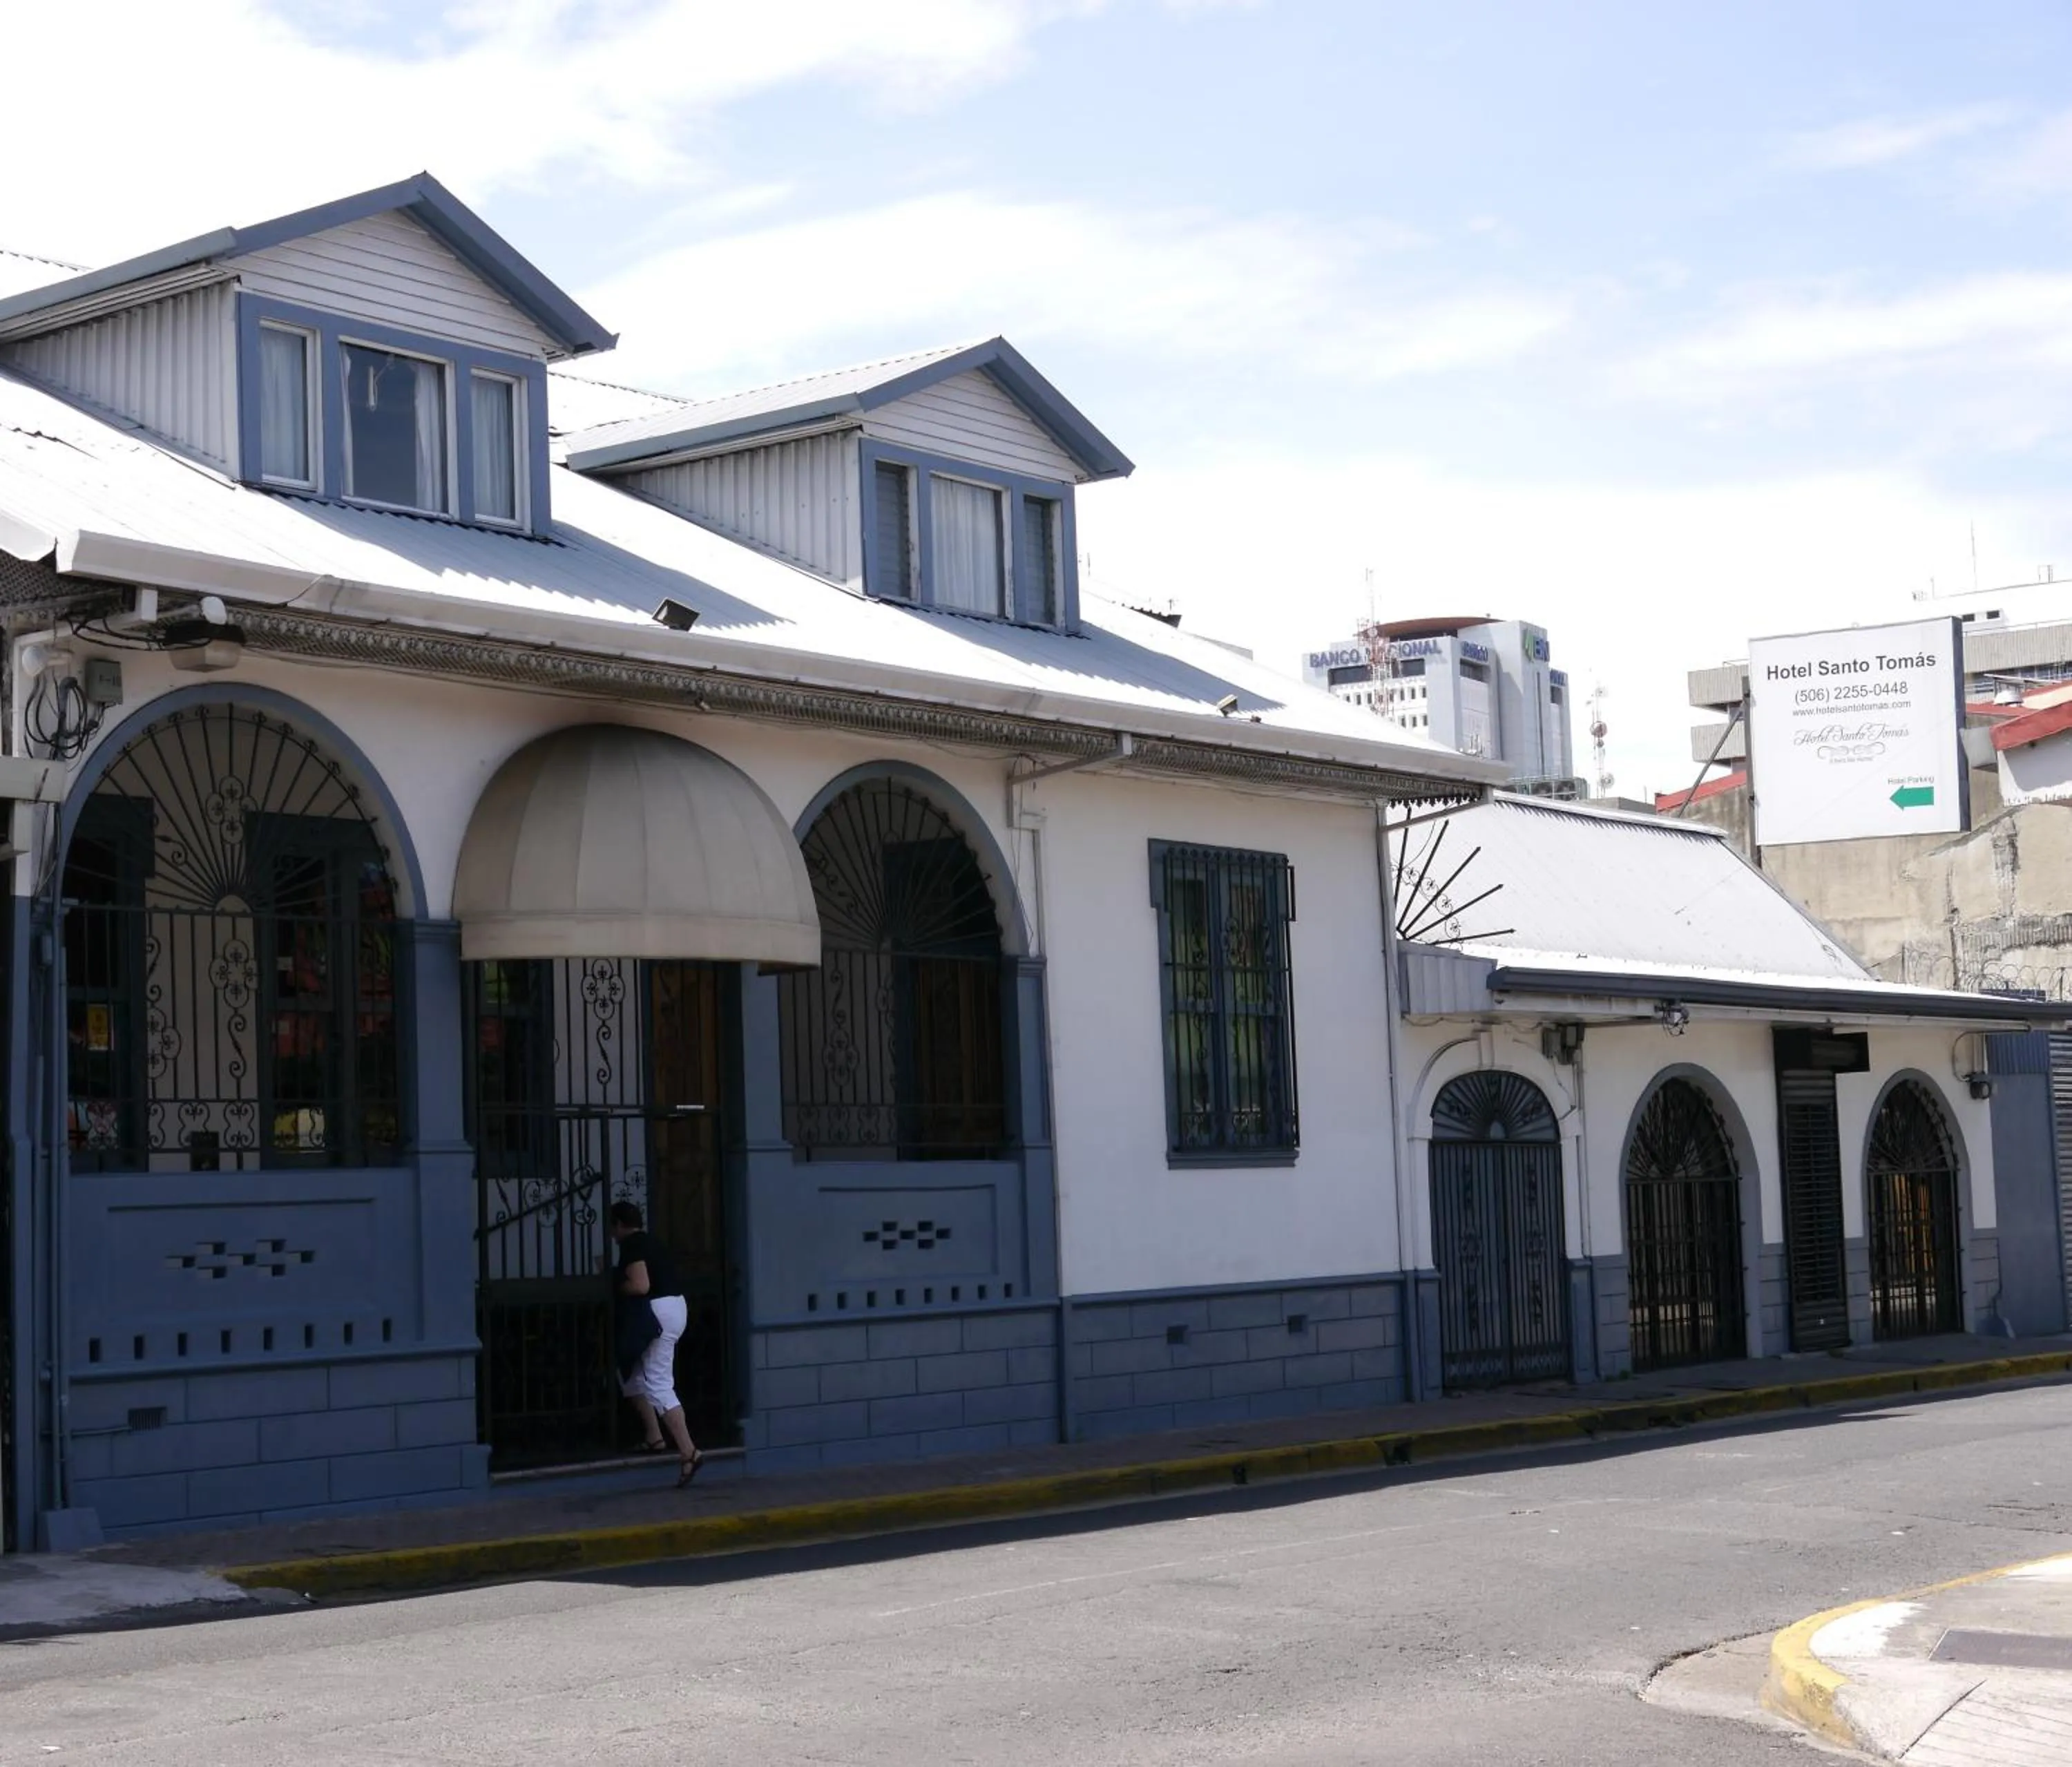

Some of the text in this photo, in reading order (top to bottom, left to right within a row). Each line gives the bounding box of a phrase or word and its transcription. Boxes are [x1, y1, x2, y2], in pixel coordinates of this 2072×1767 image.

[1310, 649, 1360, 667] BANCO
[1767, 651, 1937, 680] Hotel Santo Tomás
[1794, 681, 1908, 705] (506) 2255-0448
[1792, 700, 1912, 716] www.hotelsantotomas.com
[1794, 725, 1834, 746] Hotel
[1832, 723, 1870, 743] Santo
